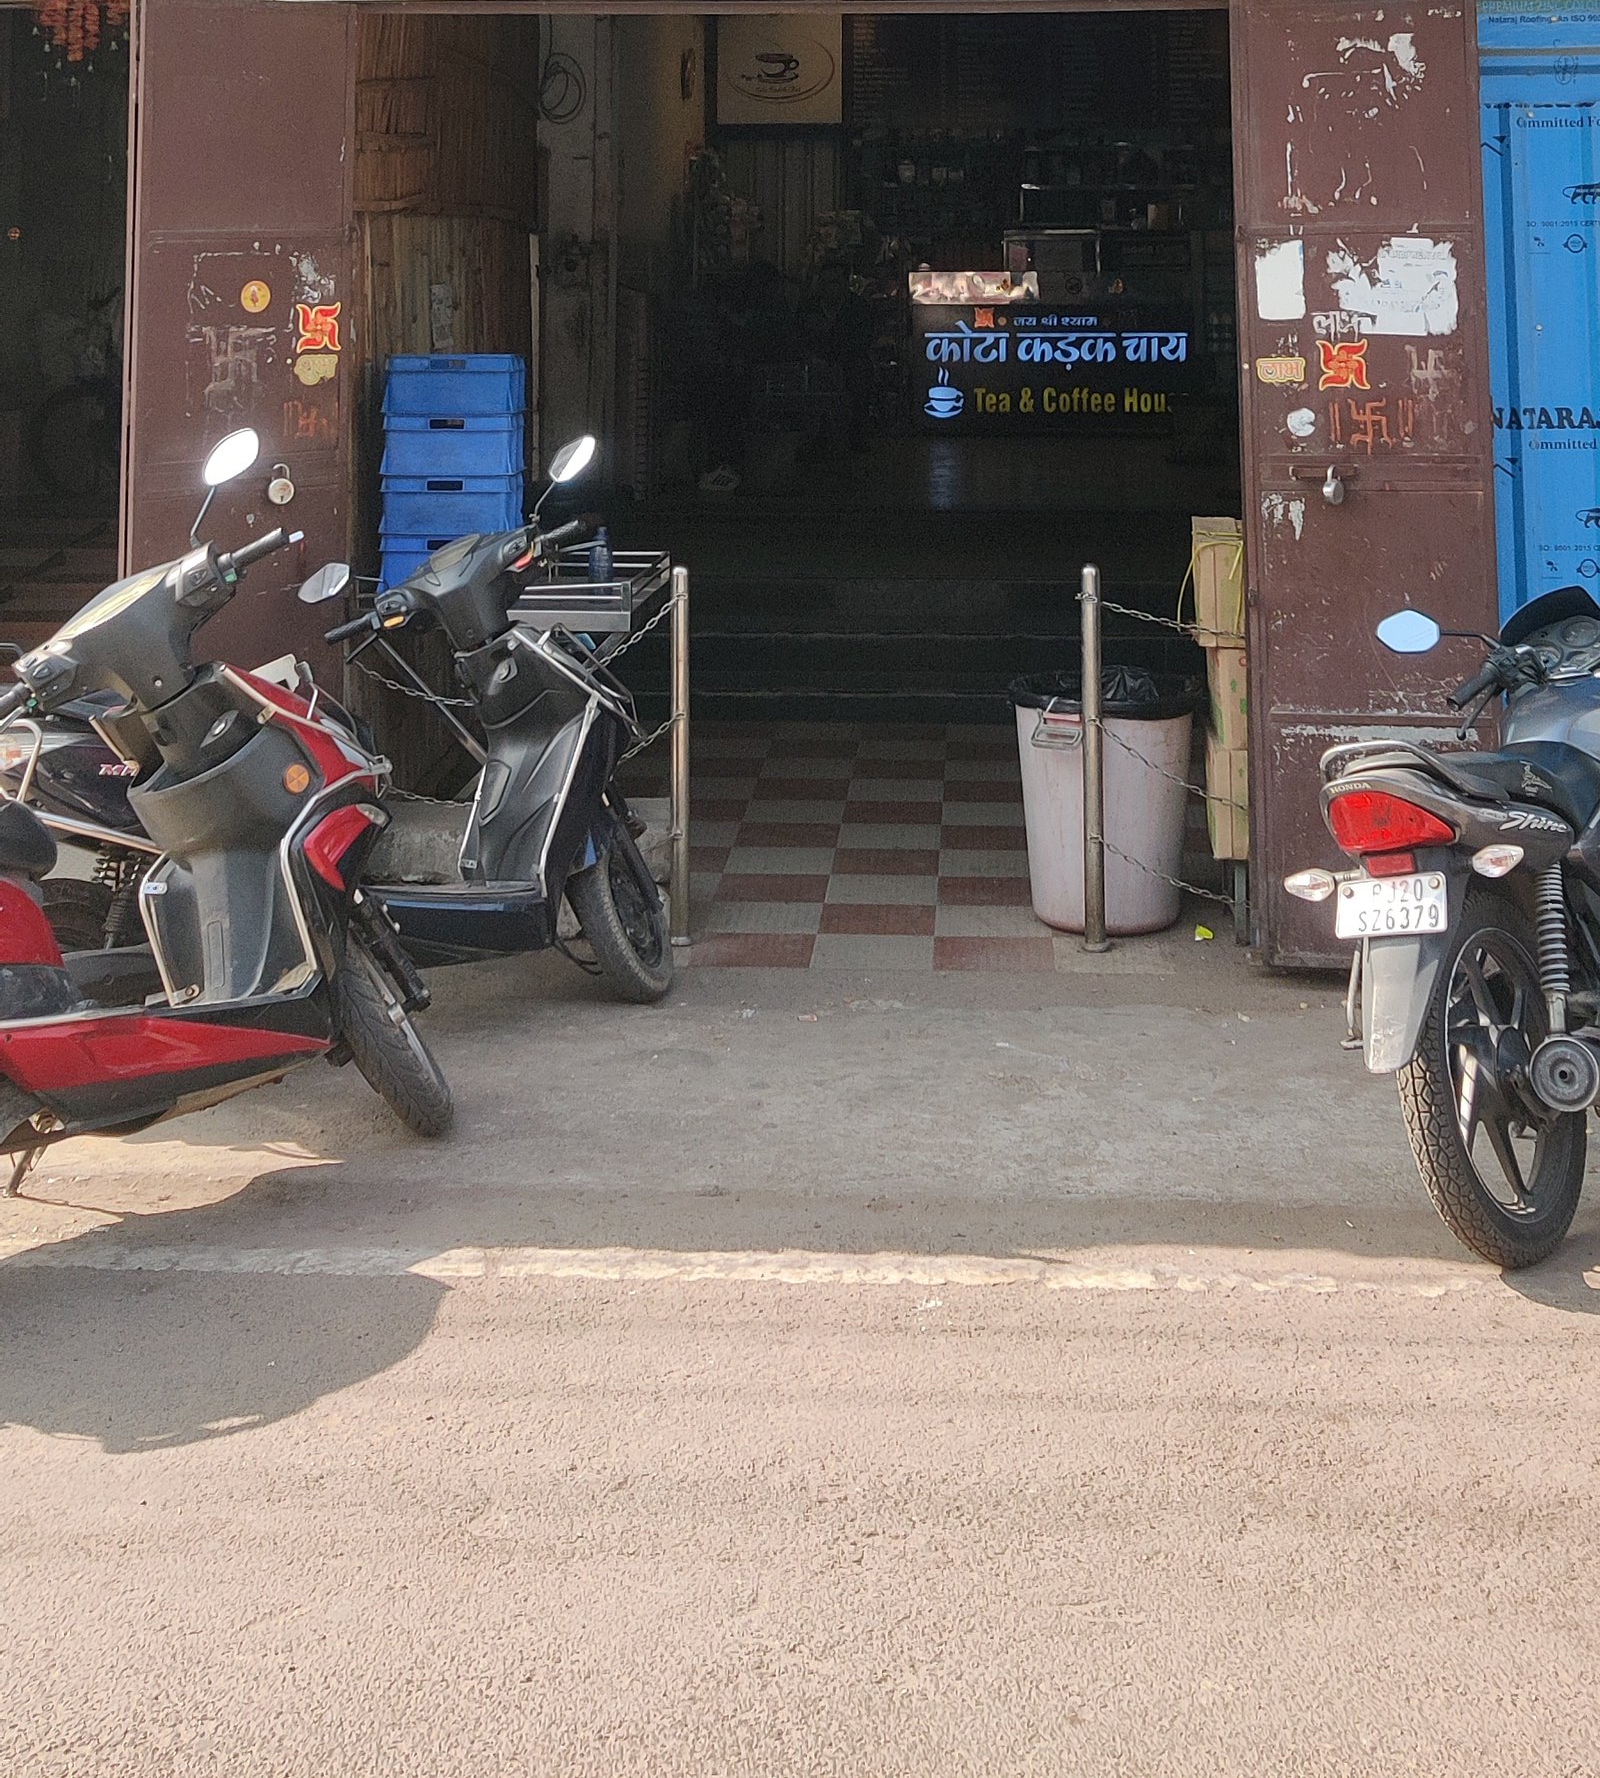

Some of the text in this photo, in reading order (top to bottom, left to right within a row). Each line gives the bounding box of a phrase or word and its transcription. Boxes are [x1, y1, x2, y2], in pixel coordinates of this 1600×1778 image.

[1013, 315, 1037, 327] जय
[924, 320, 1189, 371] कोटा कड़क चाय
[974, 387, 1180, 413] Tea & Coffee Hou
[1330, 782, 1371, 795] HONDA
[1358, 904, 1440, 933] SZ6379
